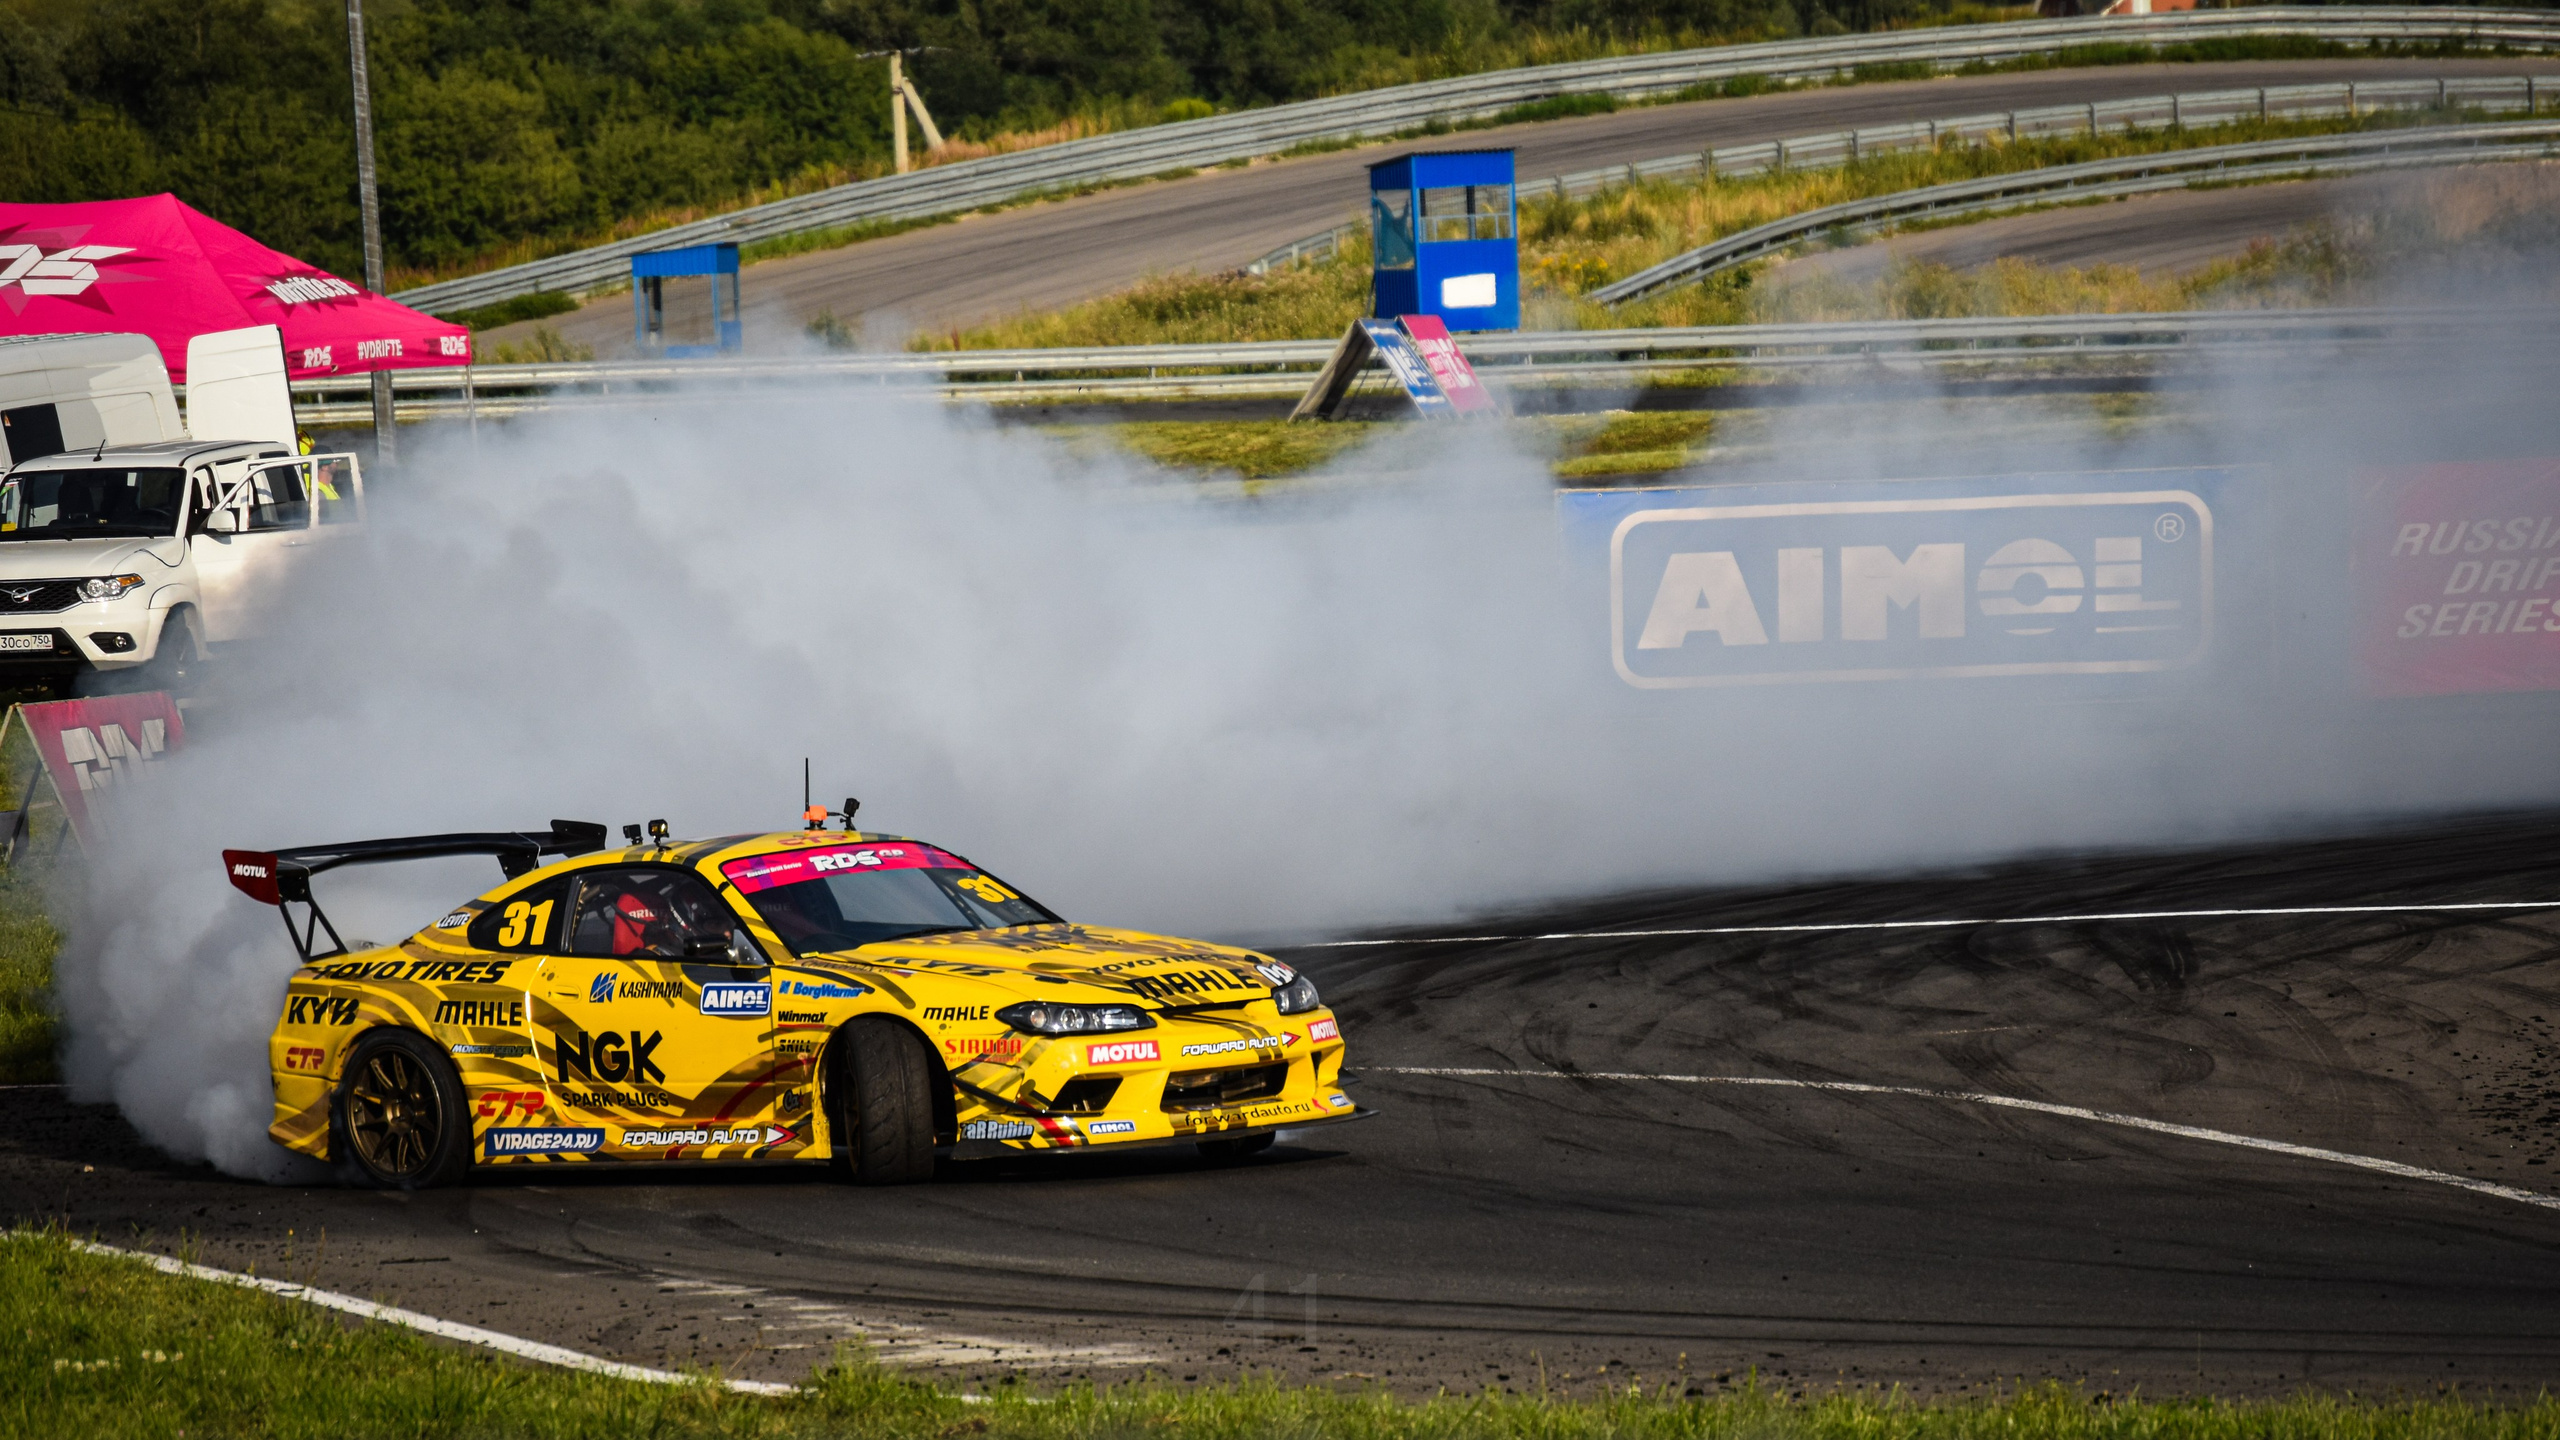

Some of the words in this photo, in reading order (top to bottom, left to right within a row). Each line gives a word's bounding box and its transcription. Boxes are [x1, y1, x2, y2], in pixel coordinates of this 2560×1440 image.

[357, 339, 402, 360] #VDRIFTE
[440, 336, 467, 355] RDS
[304, 346, 331, 368] RDS
[1636, 536, 2182, 650] AIMOL
[233, 863, 267, 878] MOTUL
[783, 862, 802, 871] Series
[809, 850, 882, 872] RDS
[957, 874, 1019, 903] 31
[436, 912, 471, 928] CLEVITE
[498, 899, 554, 947] 31
[311, 961, 406, 981] TOYO
[401, 960, 513, 984] TIRES
[1087, 959, 1156, 976] TOYO
[618, 981, 683, 998] KASHIYAMA
[793, 982, 865, 999] BorgWarner
[1124, 968, 1262, 1000] MAHLE
[703, 989, 767, 1009] AIMOL
[287, 996, 360, 1025] KYB
[433, 1000, 522, 1026] MAHLE
[923, 1006, 989, 1021] MAHLE
[1310, 1020, 1337, 1040] MOTUL
[779, 1039, 811, 1053] SKILL
[1091, 1043, 1158, 1063] MOTUL
[1182, 1040, 1247, 1056] FORWARD
[1248, 1036, 1278, 1049] AUTO
[286, 1047, 325, 1070] CTR
[554, 1030, 666, 1085] NGK
[478, 1091, 545, 1117] CTR
[561, 1091, 613, 1107] SPARK
[617, 1091, 670, 1107] PLUGS
[1185, 1102, 1312, 1126] forwardauto.ru
[621, 1130, 706, 1146] FORWARD
[710, 1129, 761, 1145] AUTO
[1091, 1123, 1134, 1134] AIMOL
[493, 1133, 598, 1151] VIRAGE24.RU
